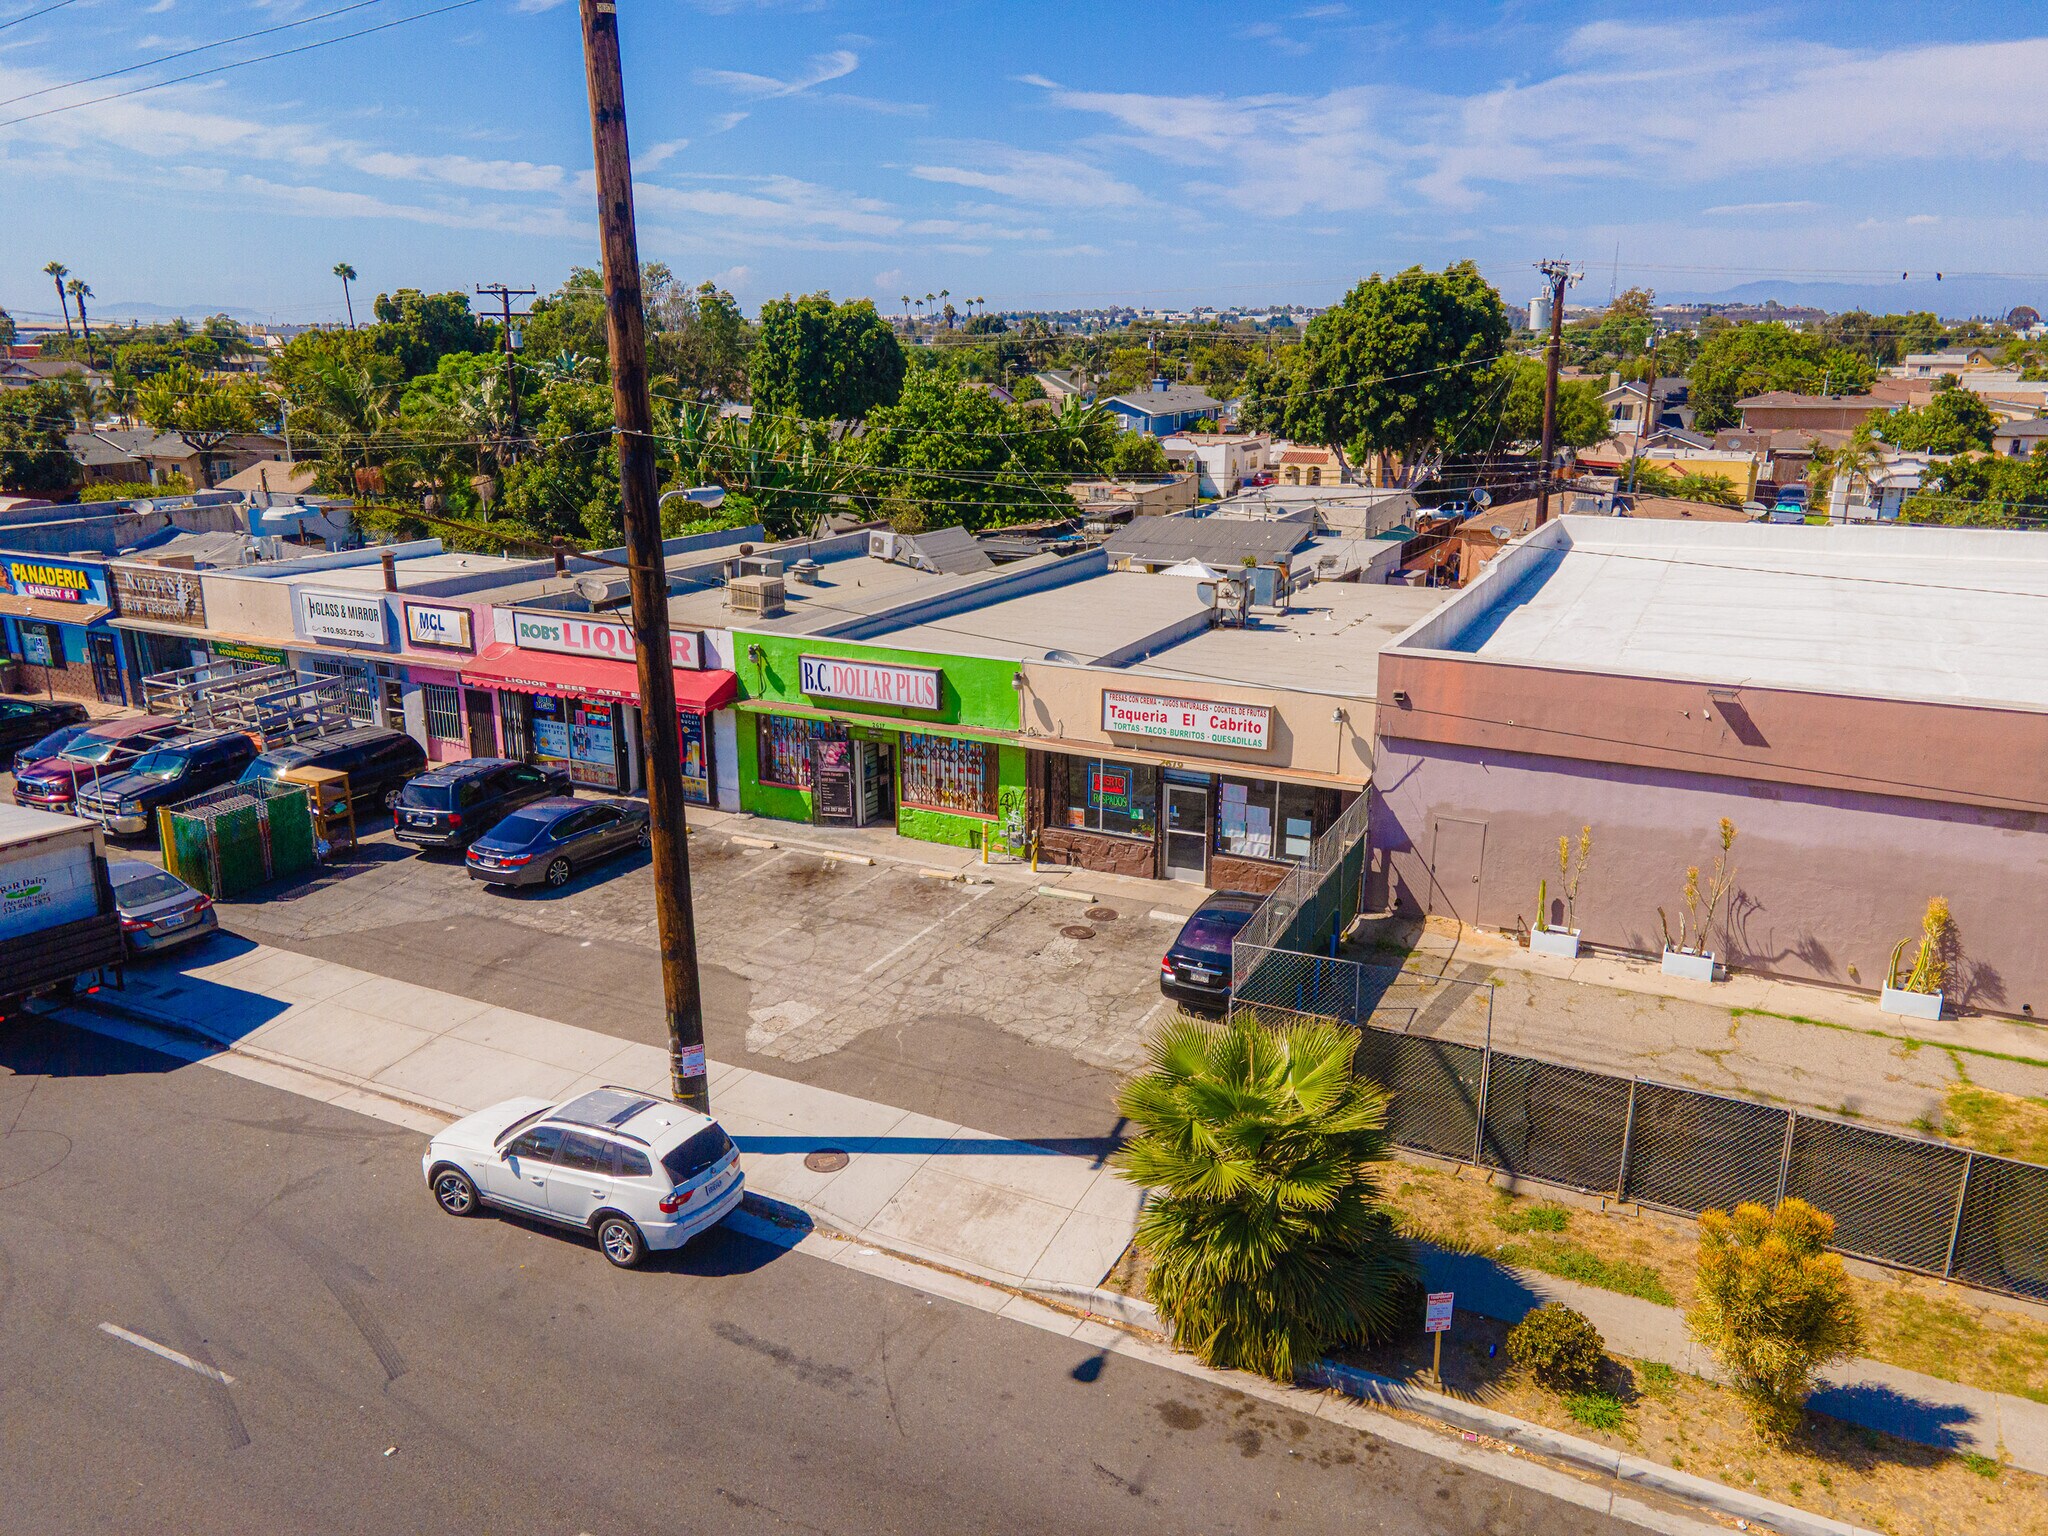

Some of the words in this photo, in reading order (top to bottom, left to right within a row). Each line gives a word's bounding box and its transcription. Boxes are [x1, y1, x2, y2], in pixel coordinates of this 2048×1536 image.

[11, 562, 89, 591] PANADERIA
[28, 585, 62, 598] BAKERY
[64, 588, 76, 599] #1
[341, 605, 347, 618] &
[347, 606, 379, 622] MIRROR
[419, 612, 446, 632] MCL
[520, 622, 560, 641] ROB'S
[562, 622, 691, 663] LIQUR
[218, 648, 281, 664] HOMEOPATICO
[505, 676, 548, 688] LIQUOR
[556, 683, 587, 693] BEER
[597, 688, 622, 697] ATM
[803, 662, 831, 693] B.C.
[833, 665, 893, 701] DOLLAR
[896, 673, 935, 706] PLUS
[1109, 693, 1128, 702] FRESAS
[1128, 695, 1139, 703] CON
[1140, 696, 1157, 705] CREMA
[1162, 700, 1179, 708] JUGOS
[1180, 701, 1209, 712] NATURALES
[1239, 708, 1246, 716] DE
[1246, 708, 1267, 718] FRUTAS
[1109, 704, 1168, 723] Taqueria
[1182, 713, 1196, 727] El
[1209, 715, 1262, 734] Cabrito
[1113, 722, 1140, 732] TORTAS
[1144, 725, 1167, 736] TACOS
[1169, 728, 1206, 741] BURRITOS
[1211, 733, 1263, 748] QUESADILLAS
